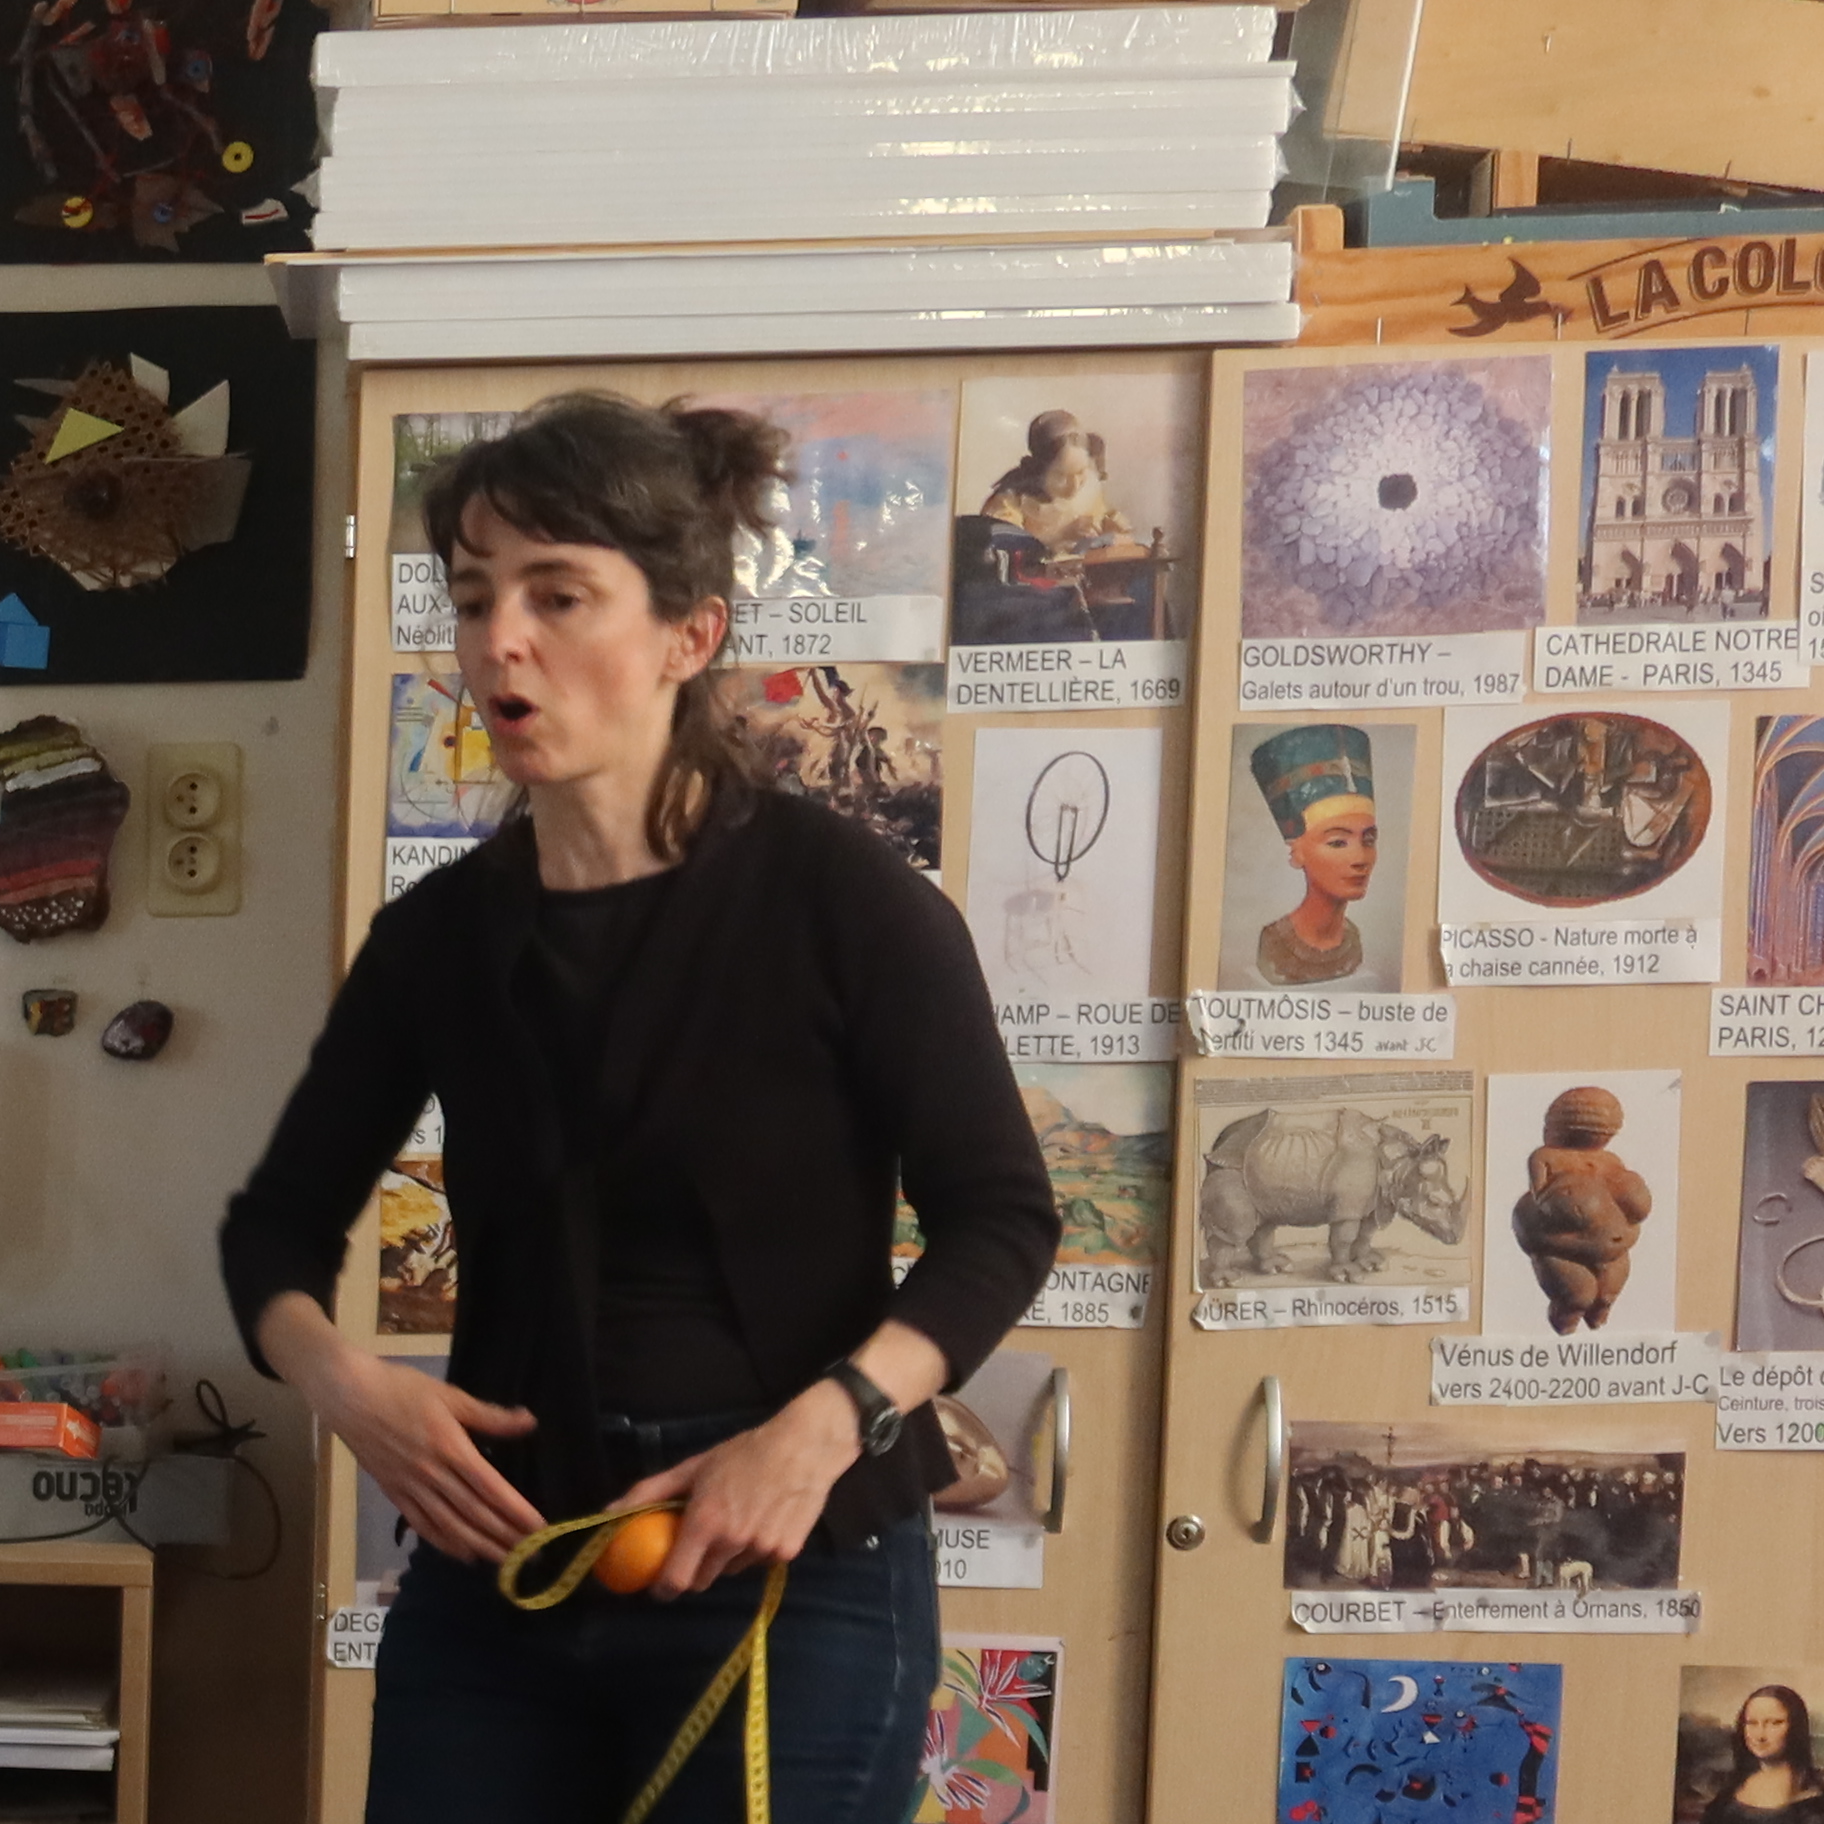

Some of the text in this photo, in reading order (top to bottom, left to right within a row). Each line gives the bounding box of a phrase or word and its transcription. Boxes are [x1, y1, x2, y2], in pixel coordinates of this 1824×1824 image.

[1584, 258, 1682, 335] LA
[399, 562, 444, 584] DOL
[788, 602, 867, 624] SOLEIL
[783, 634, 832, 655] 1872
[1546, 628, 1798, 656] CATHEDRALE NOTRE
[958, 648, 1073, 675] VERMEER
[1099, 648, 1127, 670] LA
[1242, 642, 1432, 669] GOLDSWORTHY
[1546, 664, 1613, 688] DAME
[1643, 660, 1722, 687] PARIS,
[1730, 659, 1783, 684] 1345
[957, 676, 1181, 706] DENTELLIÈRE, 1669
[1242, 673, 1521, 701] Galets autour d'un trou, 1987
[392, 845, 474, 867] KANDI
[1442, 927, 1534, 949] PICASSO
[1553, 925, 1618, 947] Nature
[1623, 926, 1679, 946] morte
[1684, 926, 1698, 945] à
[1460, 955, 1521, 979] chaise
[1528, 955, 1605, 979] cannée,
[1612, 954, 1660, 974] 1912
[1077, 1003, 1142, 1025] ROUE
[1151, 1003, 1180, 1024] DE
[1358, 1000, 1416, 1023] buste
[1422, 1000, 1448, 1023] de
[1719, 993, 1791, 1018] SAINT
[1090, 1034, 1140, 1055] 1913
[1261, 1035, 1306, 1053] vers
[1314, 1031, 1364, 1053] 1345
[1374, 1039, 1409, 1053] avant
[1718, 1026, 1798, 1052] PARIS,
[1047, 1271, 1149, 1294] ONTAGNE
[1061, 1303, 1109, 1323] 1885
[1292, 1294, 1405, 1320] Rhinocéros,
[1412, 1295, 1457, 1316] 1515
[1441, 1341, 1678, 1369] Vénus de Willendorf
[1438, 1374, 1709, 1400] vers 2400-2200 avant J-C
[1719, 1362, 1814, 1393] Le dépôt
[1718, 1395, 1789, 1413] Ceinture,
[1718, 1423, 1767, 1444] Vers
[334, 1612, 385, 1632] DEG
[1293, 1602, 1406, 1625] COURBET
[1433, 1601, 1549, 1622] Enterrement
[1554, 1601, 1567, 1620] à
[1573, 1598, 1648, 1621] Ornans,
[1655, 1597, 1701, 1618] 1850
[334, 1642, 377, 1662] ENT
